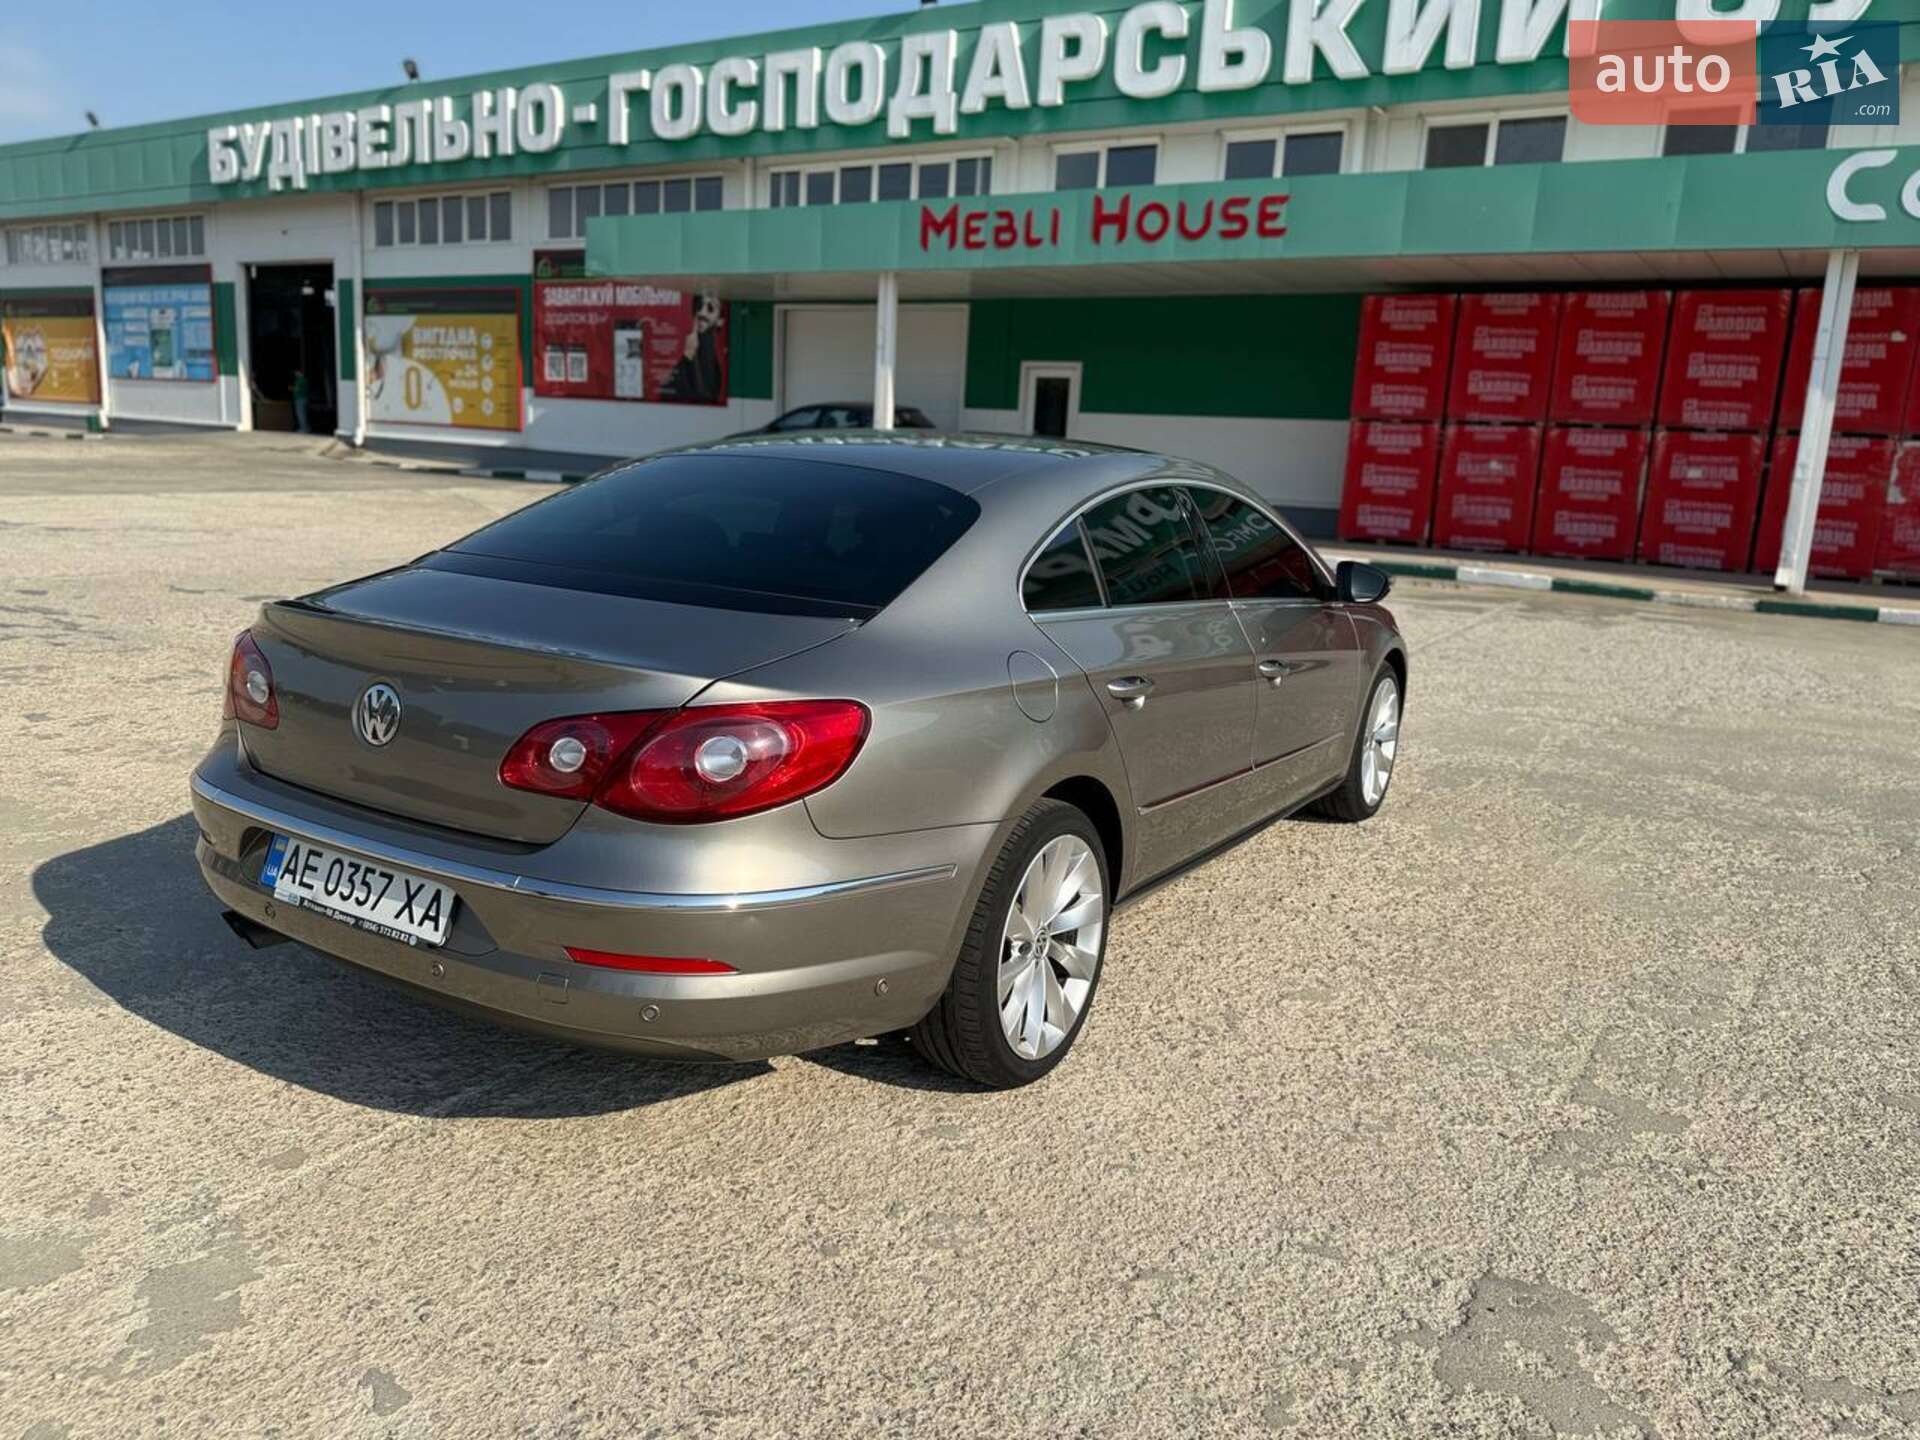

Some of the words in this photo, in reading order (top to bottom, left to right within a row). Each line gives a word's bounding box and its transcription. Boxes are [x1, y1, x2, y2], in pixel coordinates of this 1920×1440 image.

[1091, 193, 1291, 245] HOUSE
[280, 844, 323, 891] AE
[323, 858, 394, 911] 0357
[394, 878, 443, 932] XA
